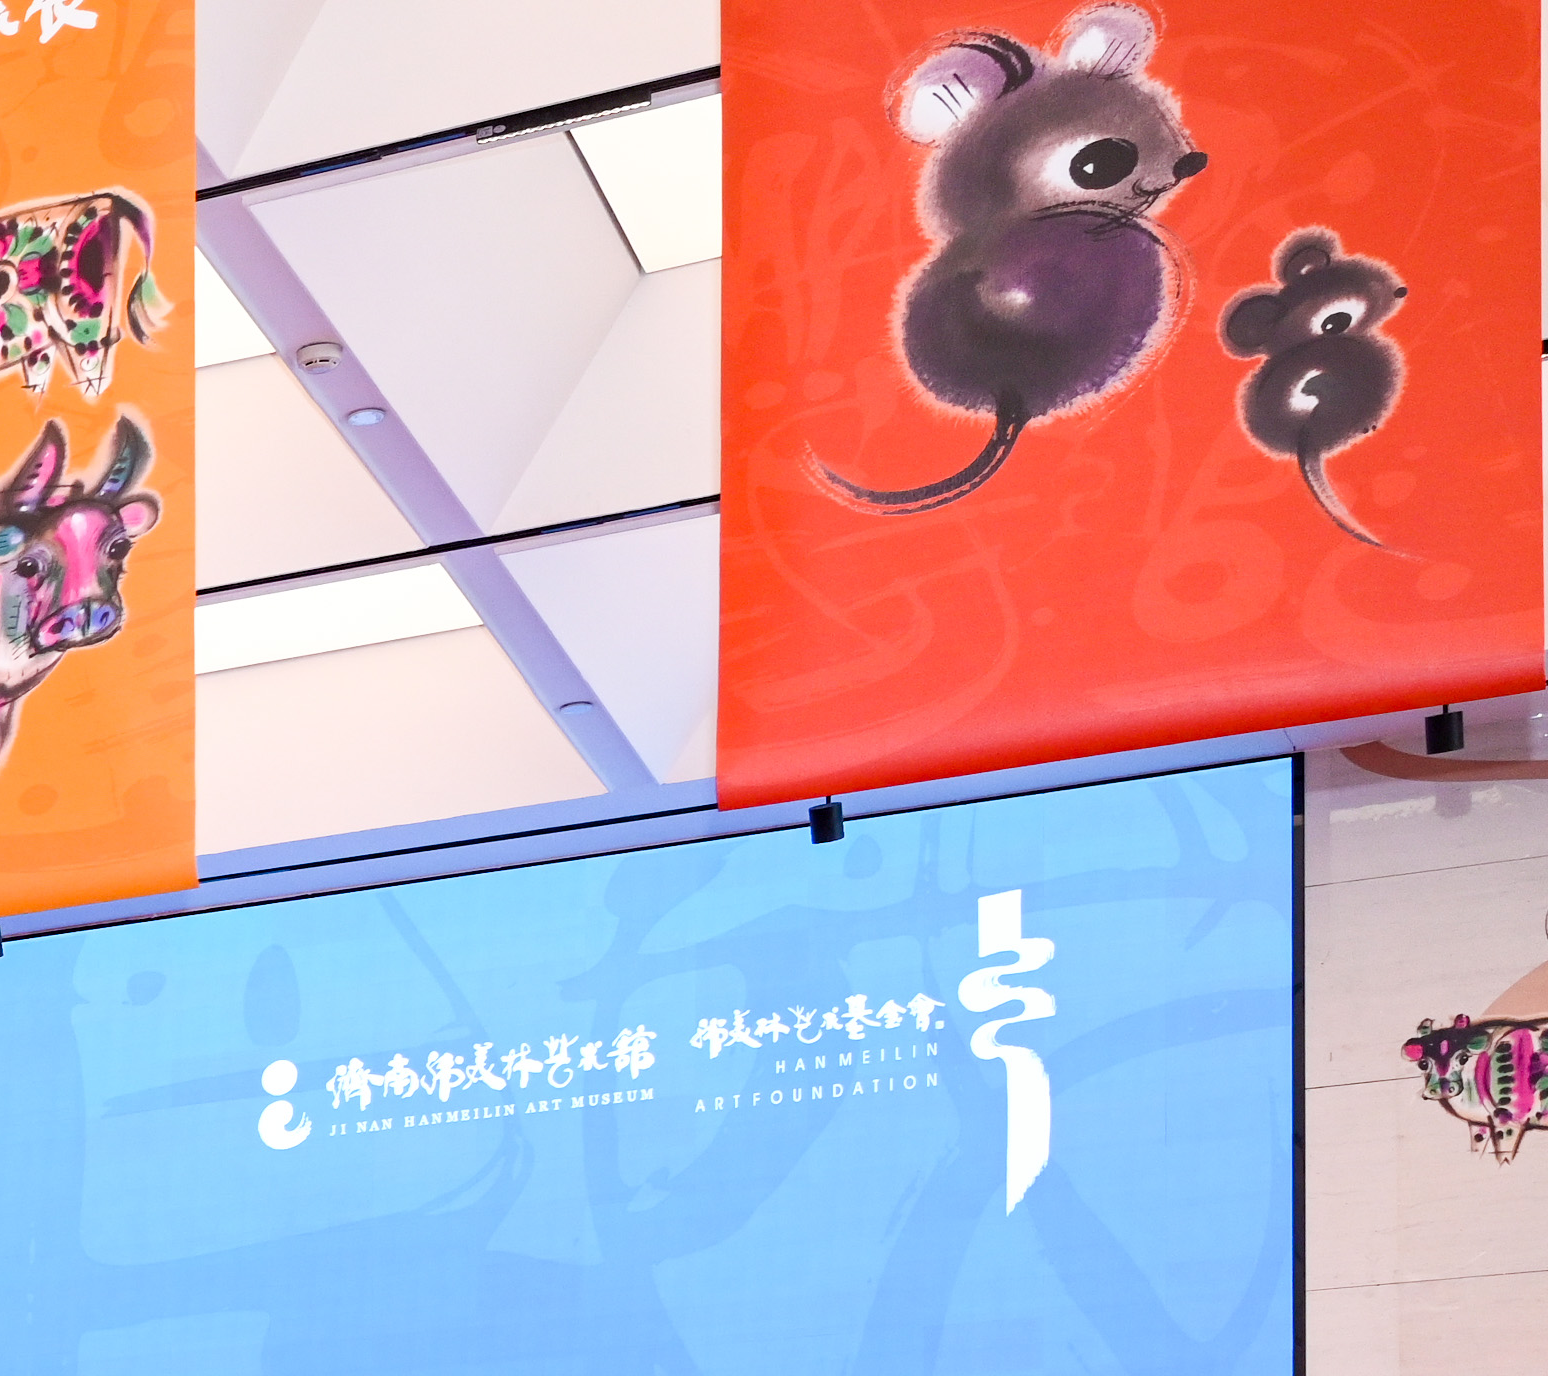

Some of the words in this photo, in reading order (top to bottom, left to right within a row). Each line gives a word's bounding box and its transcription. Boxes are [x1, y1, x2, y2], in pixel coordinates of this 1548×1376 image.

[329, 1123, 347, 1137] JI
[356, 1117, 394, 1133] NAN
[404, 1103, 515, 1128] HANMEILIN
[525, 1098, 562, 1114] ART
[571, 1087, 655, 1109] MUSEUM
